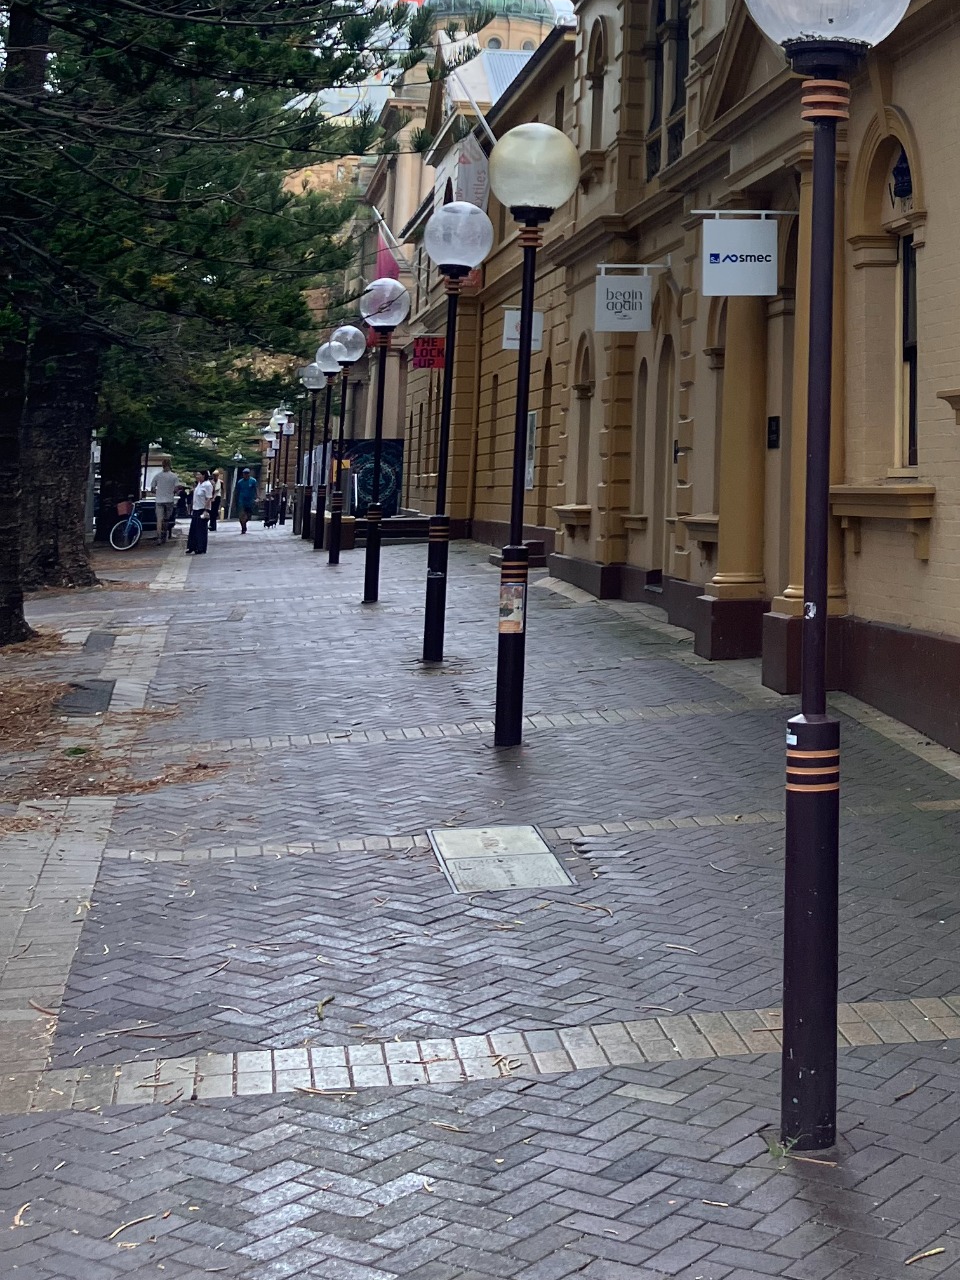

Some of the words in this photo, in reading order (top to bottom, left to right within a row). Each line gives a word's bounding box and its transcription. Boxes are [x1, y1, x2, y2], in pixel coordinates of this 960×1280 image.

[739, 254, 772, 263] smec
[606, 287, 643, 302] begin
[606, 301, 643, 314] again
[414, 336, 438, 347] THE
[413, 348, 445, 358] LOCK
